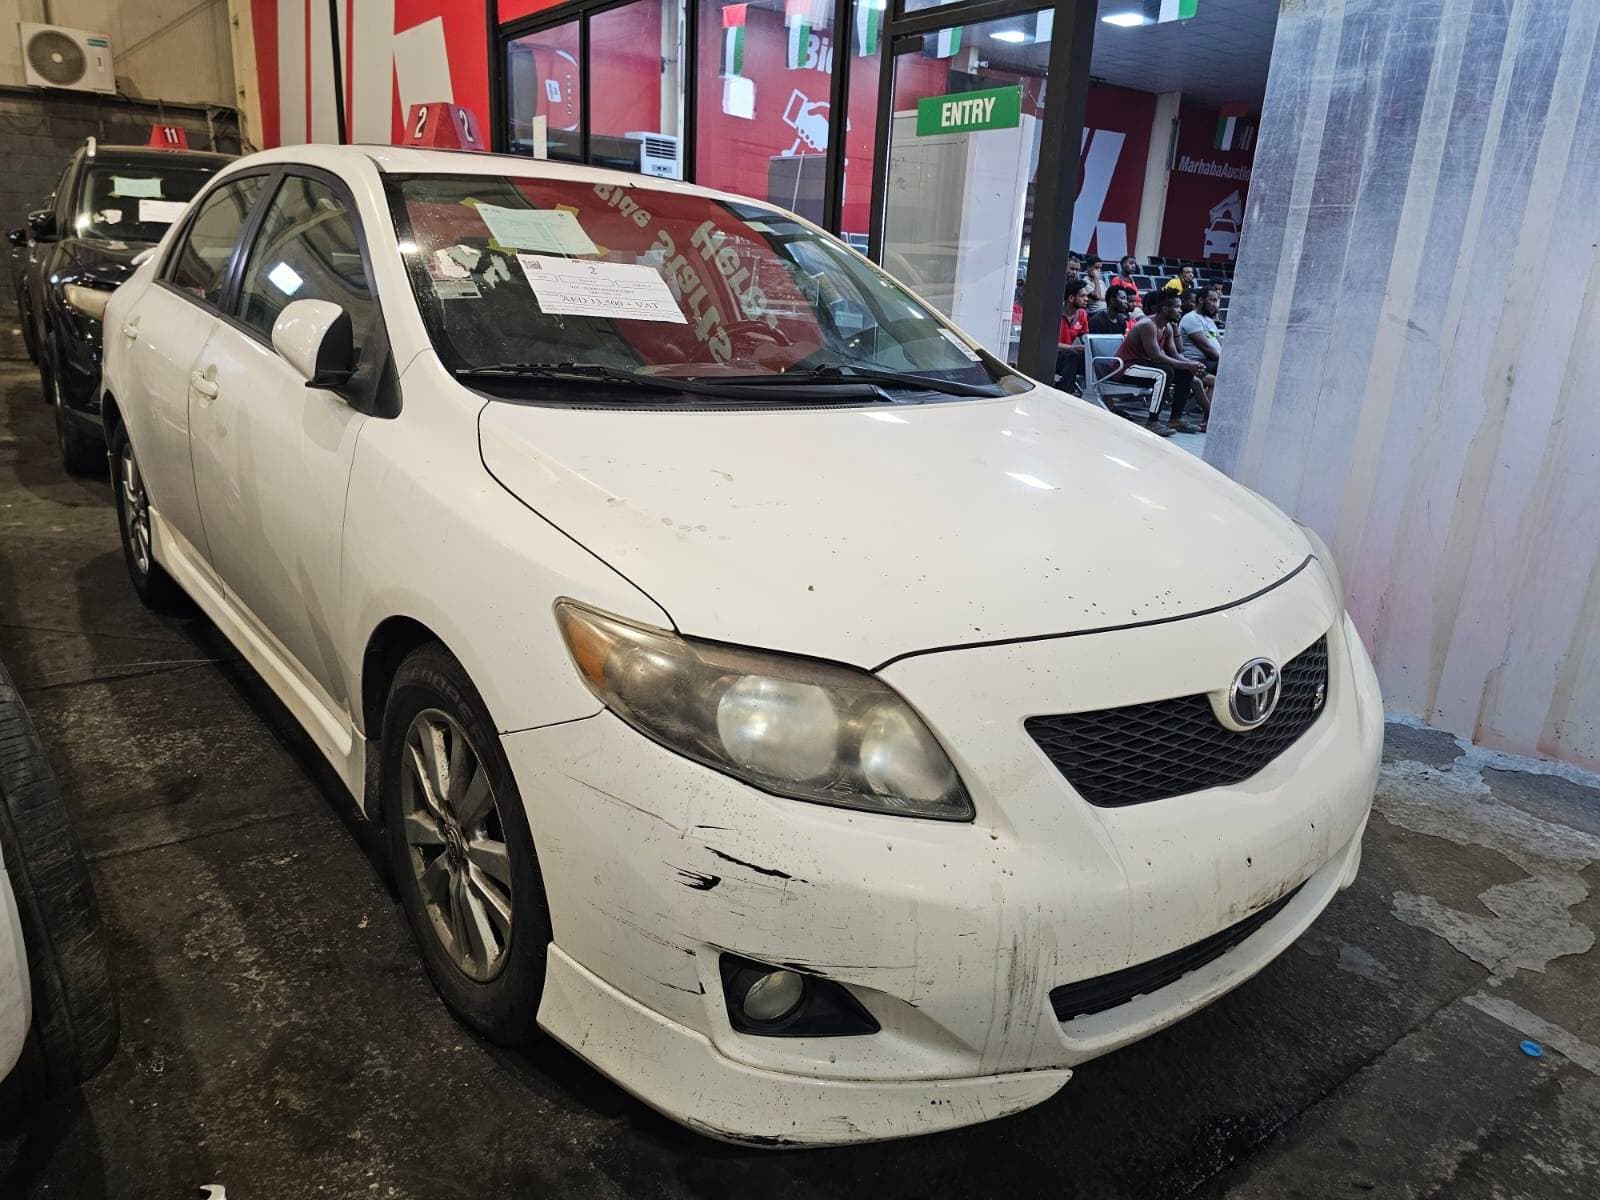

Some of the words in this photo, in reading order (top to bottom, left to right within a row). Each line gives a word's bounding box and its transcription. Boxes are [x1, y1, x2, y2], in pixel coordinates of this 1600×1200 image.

[413, 105, 429, 139] 2
[941, 97, 996, 128] ENTRY
[164, 127, 179, 144] 11
[457, 107, 475, 143] 2
[588, 266, 598, 275] 2
[634, 301, 659, 309] VAT
